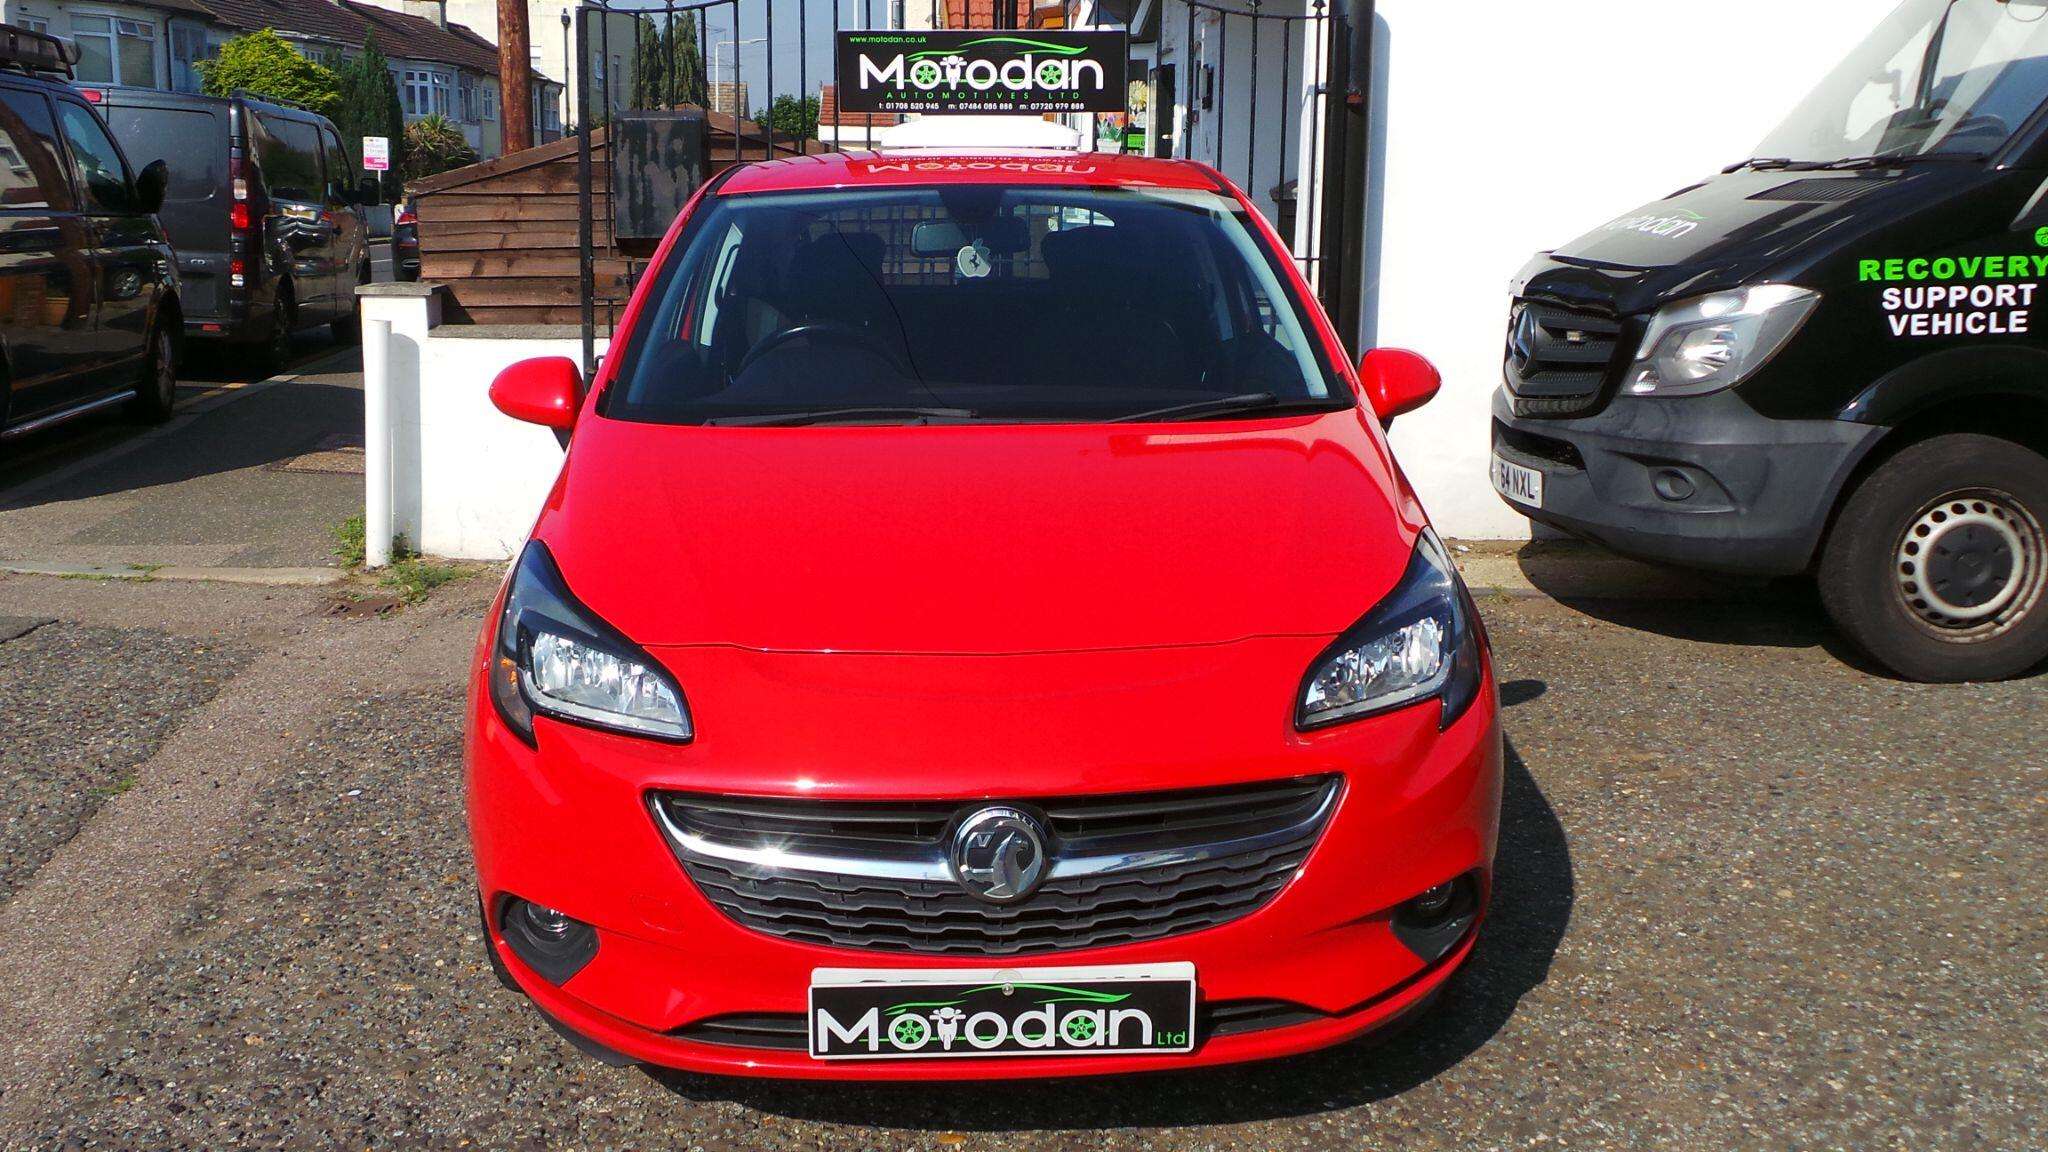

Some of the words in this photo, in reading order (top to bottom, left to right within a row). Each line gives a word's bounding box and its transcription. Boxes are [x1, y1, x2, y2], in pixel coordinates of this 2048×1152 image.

[849, 36, 927, 44] www.motodan.co.uk
[860, 53, 1104, 91] Motodan
[885, 102, 909, 110] 01708
[910, 102, 924, 110] 520
[925, 102, 940, 110] 945
[1030, 102, 1054, 110] 07720
[1054, 102, 1069, 110] 979
[886, 91, 1029, 100] AUTOMOTIVES
[1048, 91, 1081, 100] LTD
[1859, 255, 2048, 281] RECOVERY
[1881, 283, 2038, 310] SUPPORT
[1888, 310, 2029, 336] VEHICLE
[1512, 467, 1536, 500] NXL
[816, 1003, 1154, 1053] Motodan
[1156, 1030, 1187, 1046] Ltd
